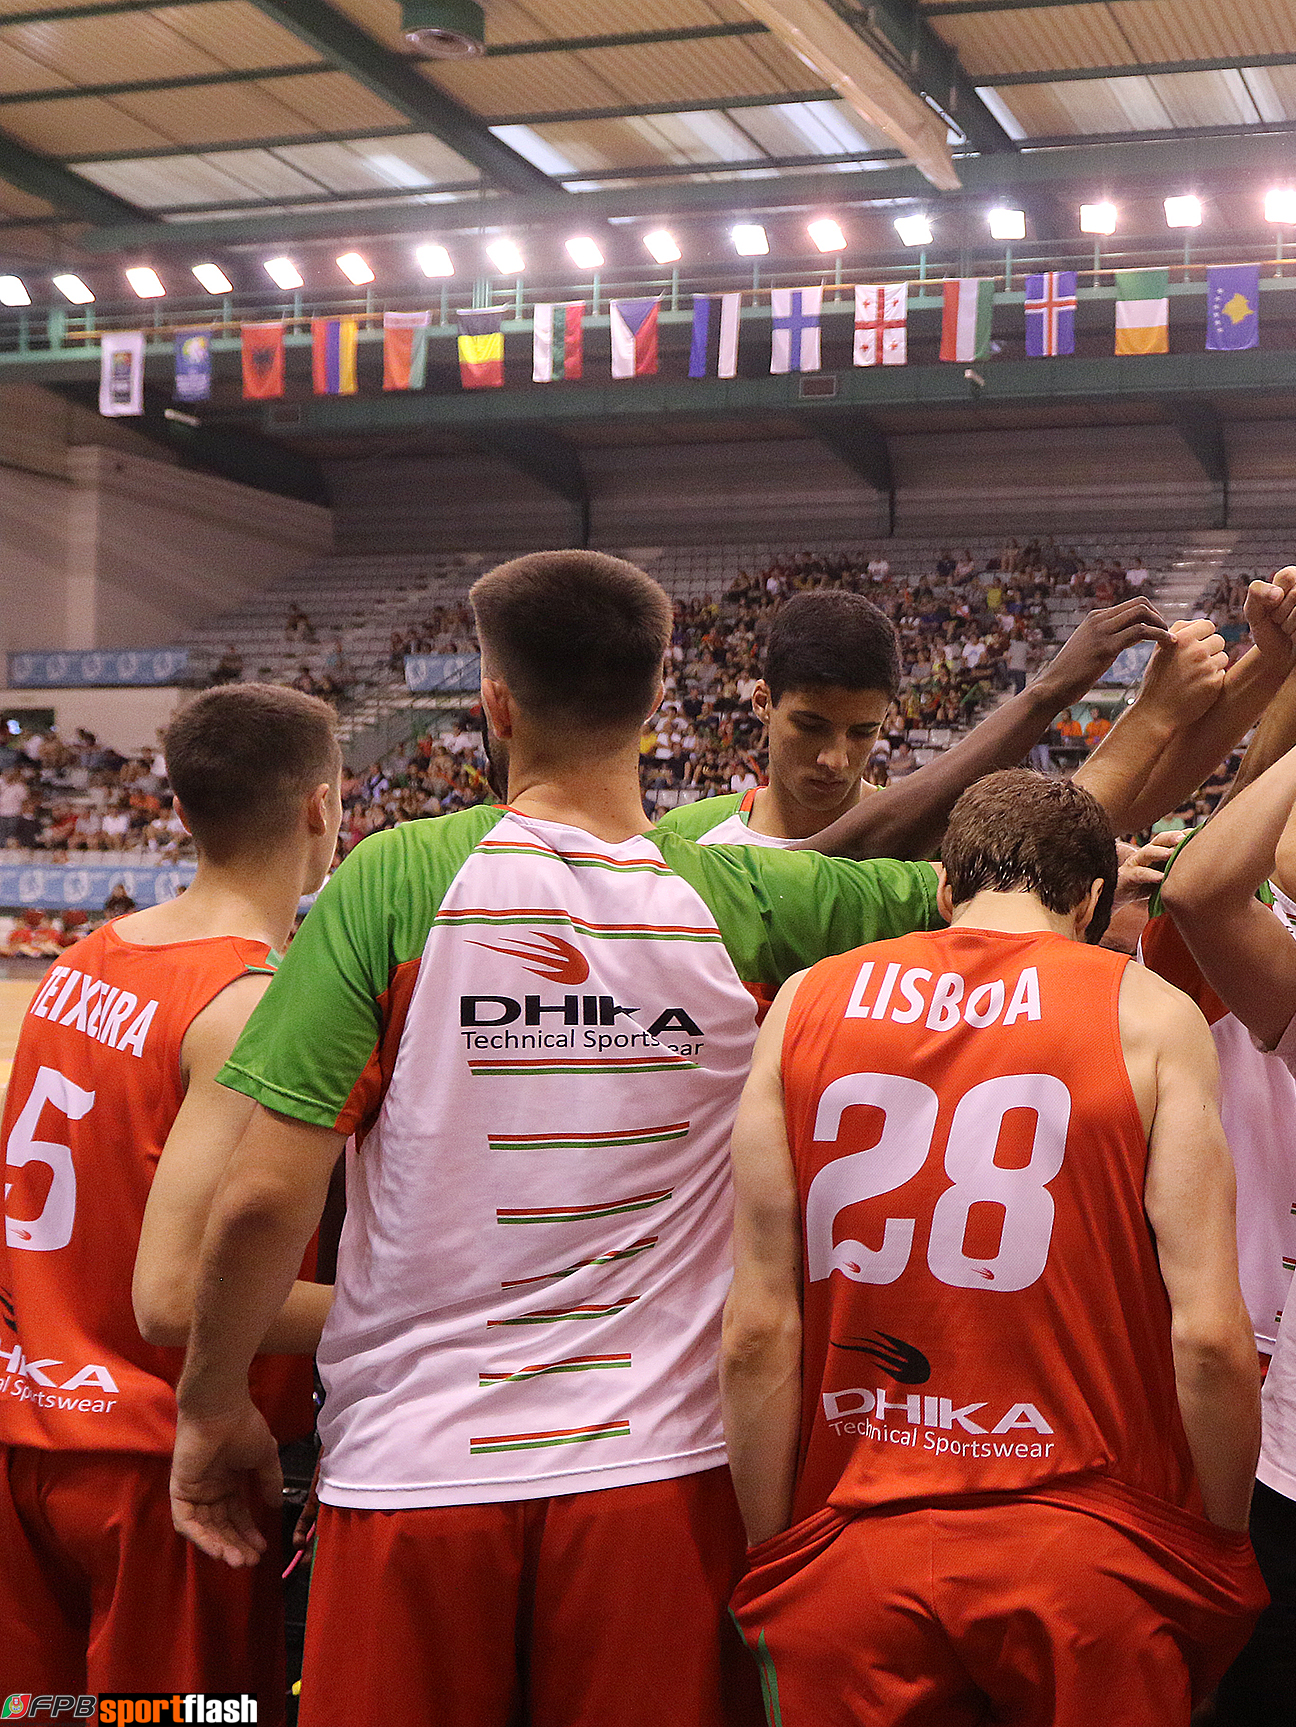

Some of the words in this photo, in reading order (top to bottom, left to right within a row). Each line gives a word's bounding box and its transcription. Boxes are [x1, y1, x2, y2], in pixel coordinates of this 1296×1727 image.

[30, 966, 160, 1058] TEIXEIRA
[461, 995, 705, 1037] DHIKA
[844, 961, 1042, 1032] LISBOA
[461, 1030, 575, 1050] Technical
[583, 1030, 705, 1056] Sportsear
[5, 1066, 96, 1252] 5
[806, 1072, 1072, 1293] 28
[823, 1388, 1055, 1435] DHIKA
[829, 1418, 918, 1447] Technical
[923, 1431, 1055, 1458] Sportswear
